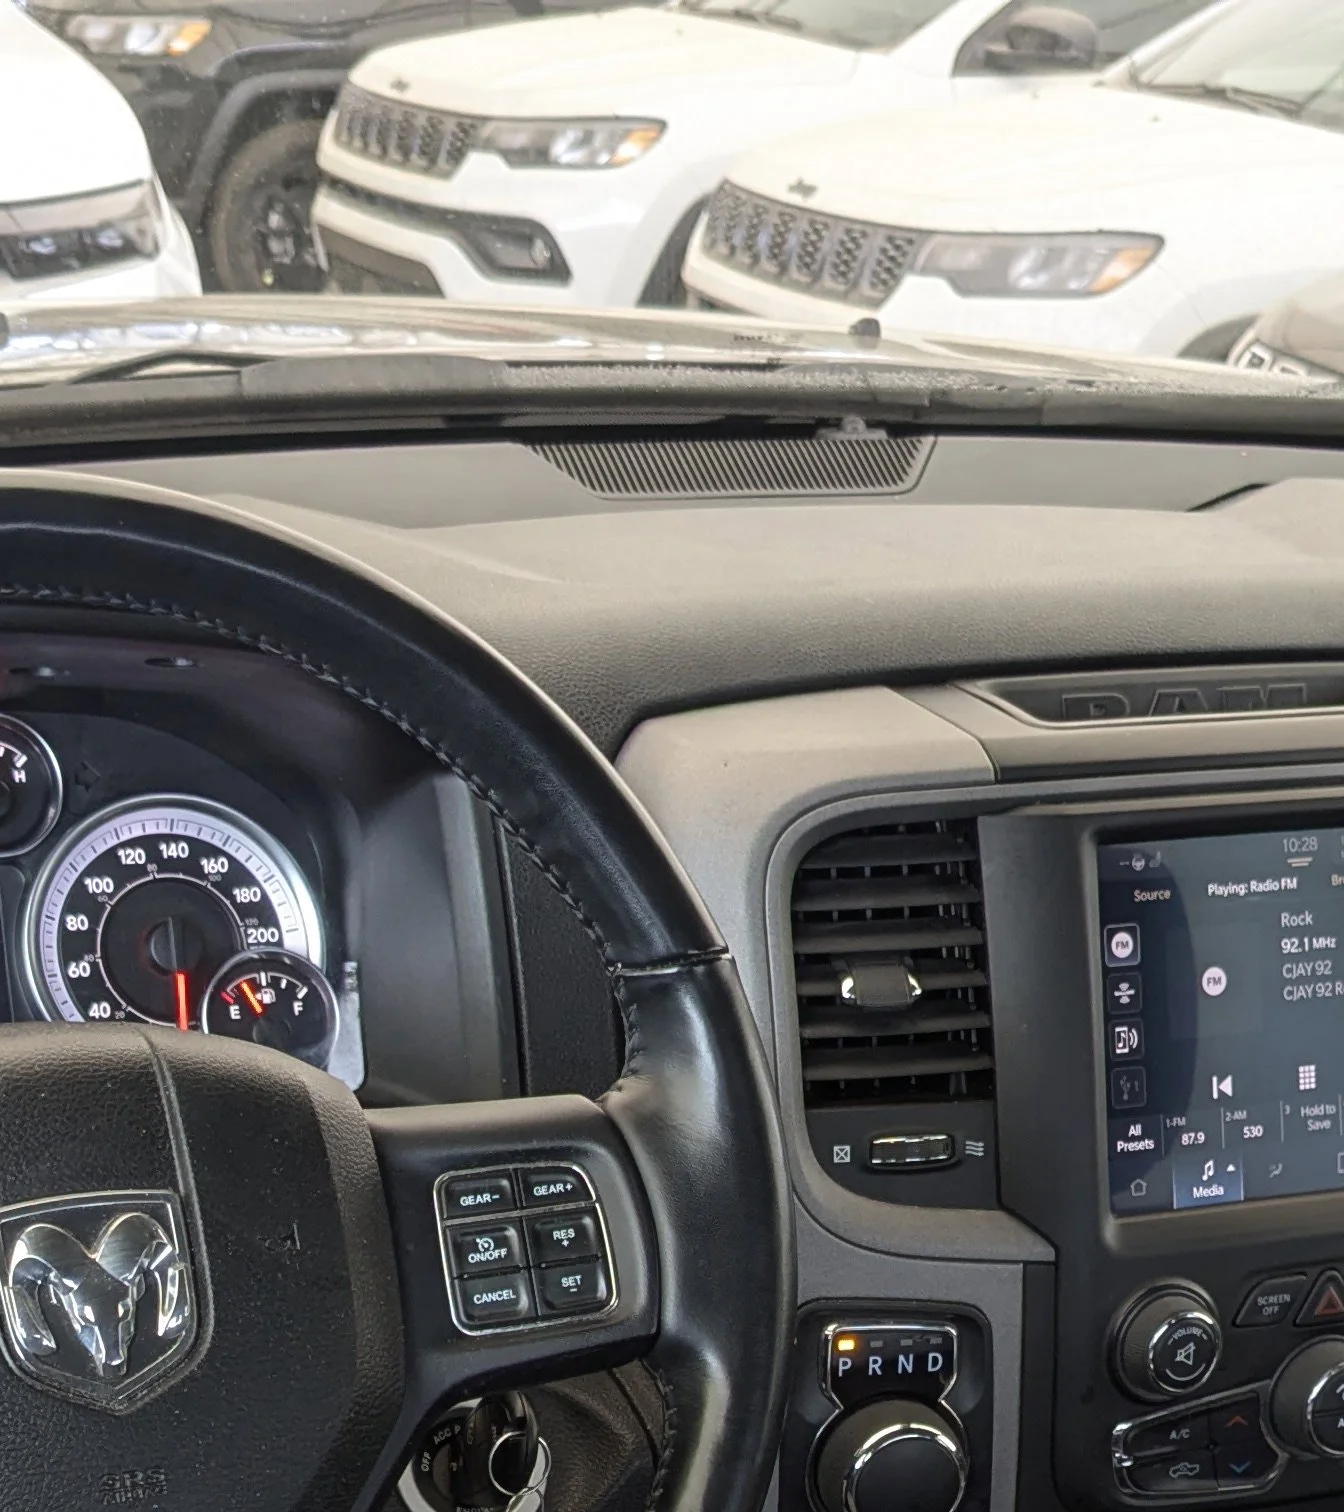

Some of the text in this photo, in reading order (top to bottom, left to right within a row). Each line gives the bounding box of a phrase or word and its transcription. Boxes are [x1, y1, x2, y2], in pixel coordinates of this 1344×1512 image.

[159, 841, 189, 859] 140
[1282, 836, 1318, 853] 10:28
[117, 848, 146, 865] 120
[201, 856, 229, 874] 160
[84, 876, 114, 894] 100
[1207, 877, 1298, 898] Playing: Radio FM
[232, 887, 261, 904] 180
[1134, 889, 1171, 902] Source
[65, 914, 89, 931] 80
[1281, 910, 1313, 928] Rock
[246, 927, 279, 944] 200
[1115, 940, 1129, 951] FM
[1281, 936, 1337, 954] 92.1 MHz
[68, 961, 91, 979] 60
[1282, 960, 1332, 980] CJAY 92
[1206, 976, 1222, 987] FM
[1283, 985, 1314, 1002] CJAY
[1315, 982, 1333, 998] 92
[89, 1003, 111, 1019] 40
[229, 1005, 241, 1020] E
[293, 1001, 304, 1016] F
[1300, 1103, 1336, 1117] Hold to
[1128, 1123, 1142, 1137] All
[1243, 1125, 1264, 1139] 530
[1307, 1118, 1332, 1131] Save
[1116, 1138, 1155, 1153] Presets
[1181, 1131, 1205, 1146] 87.9
[1192, 1184, 1225, 1199] Media
[553, 1228, 576, 1241] RES
[468, 1247, 508, 1264] ON/OFF
[561, 1275, 582, 1288] SET
[473, 1288, 517, 1304] CANCEL
[1257, 1293, 1292, 1308] SCREEN
[1262, 1304, 1280, 1317] OFF
[838, 1352, 944, 1378] P R N D
[1169, 1427, 1190, 1441] A/C
